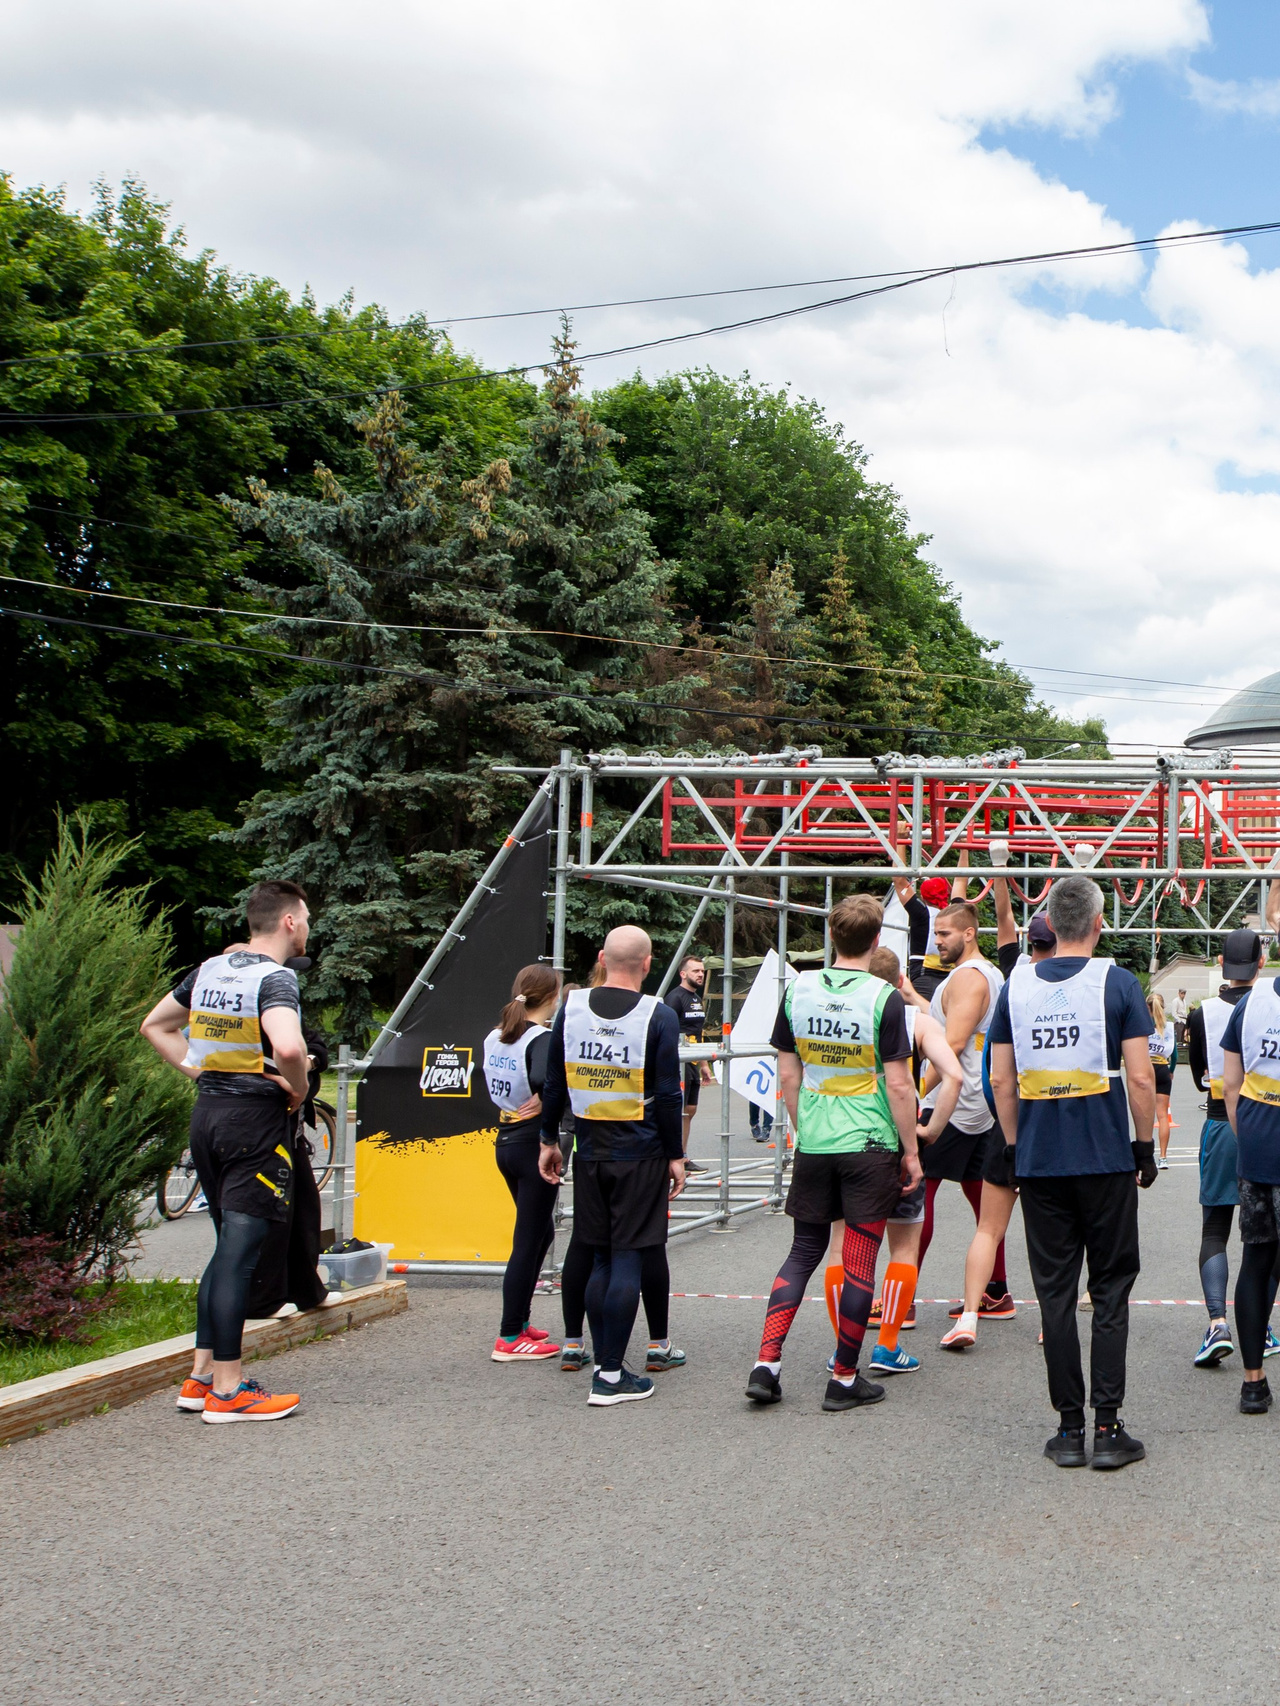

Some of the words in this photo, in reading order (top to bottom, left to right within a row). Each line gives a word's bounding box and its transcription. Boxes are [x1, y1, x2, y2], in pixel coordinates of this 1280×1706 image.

[200, 988, 243, 1012] 1124-3
[196, 1014, 243, 1030] КОМАНДНЫЙ
[1034, 1012, 1077, 1023] AMTEX
[204, 1027, 228, 1039] СТАРТ
[807, 1016, 860, 1040] 1124-2
[1031, 1025, 1080, 1050] 5259
[579, 1041, 630, 1064] 1124-1
[807, 1041, 862, 1056] КОМАНДНЫЙ
[488, 1055, 517, 1071] CUSTIS
[821, 1054, 847, 1065] СТАРТ
[419, 1061, 475, 1092] URBAN
[576, 1066, 631, 1080] КОМАНДНЫЙ
[588, 1078, 615, 1089] СТАРТ
